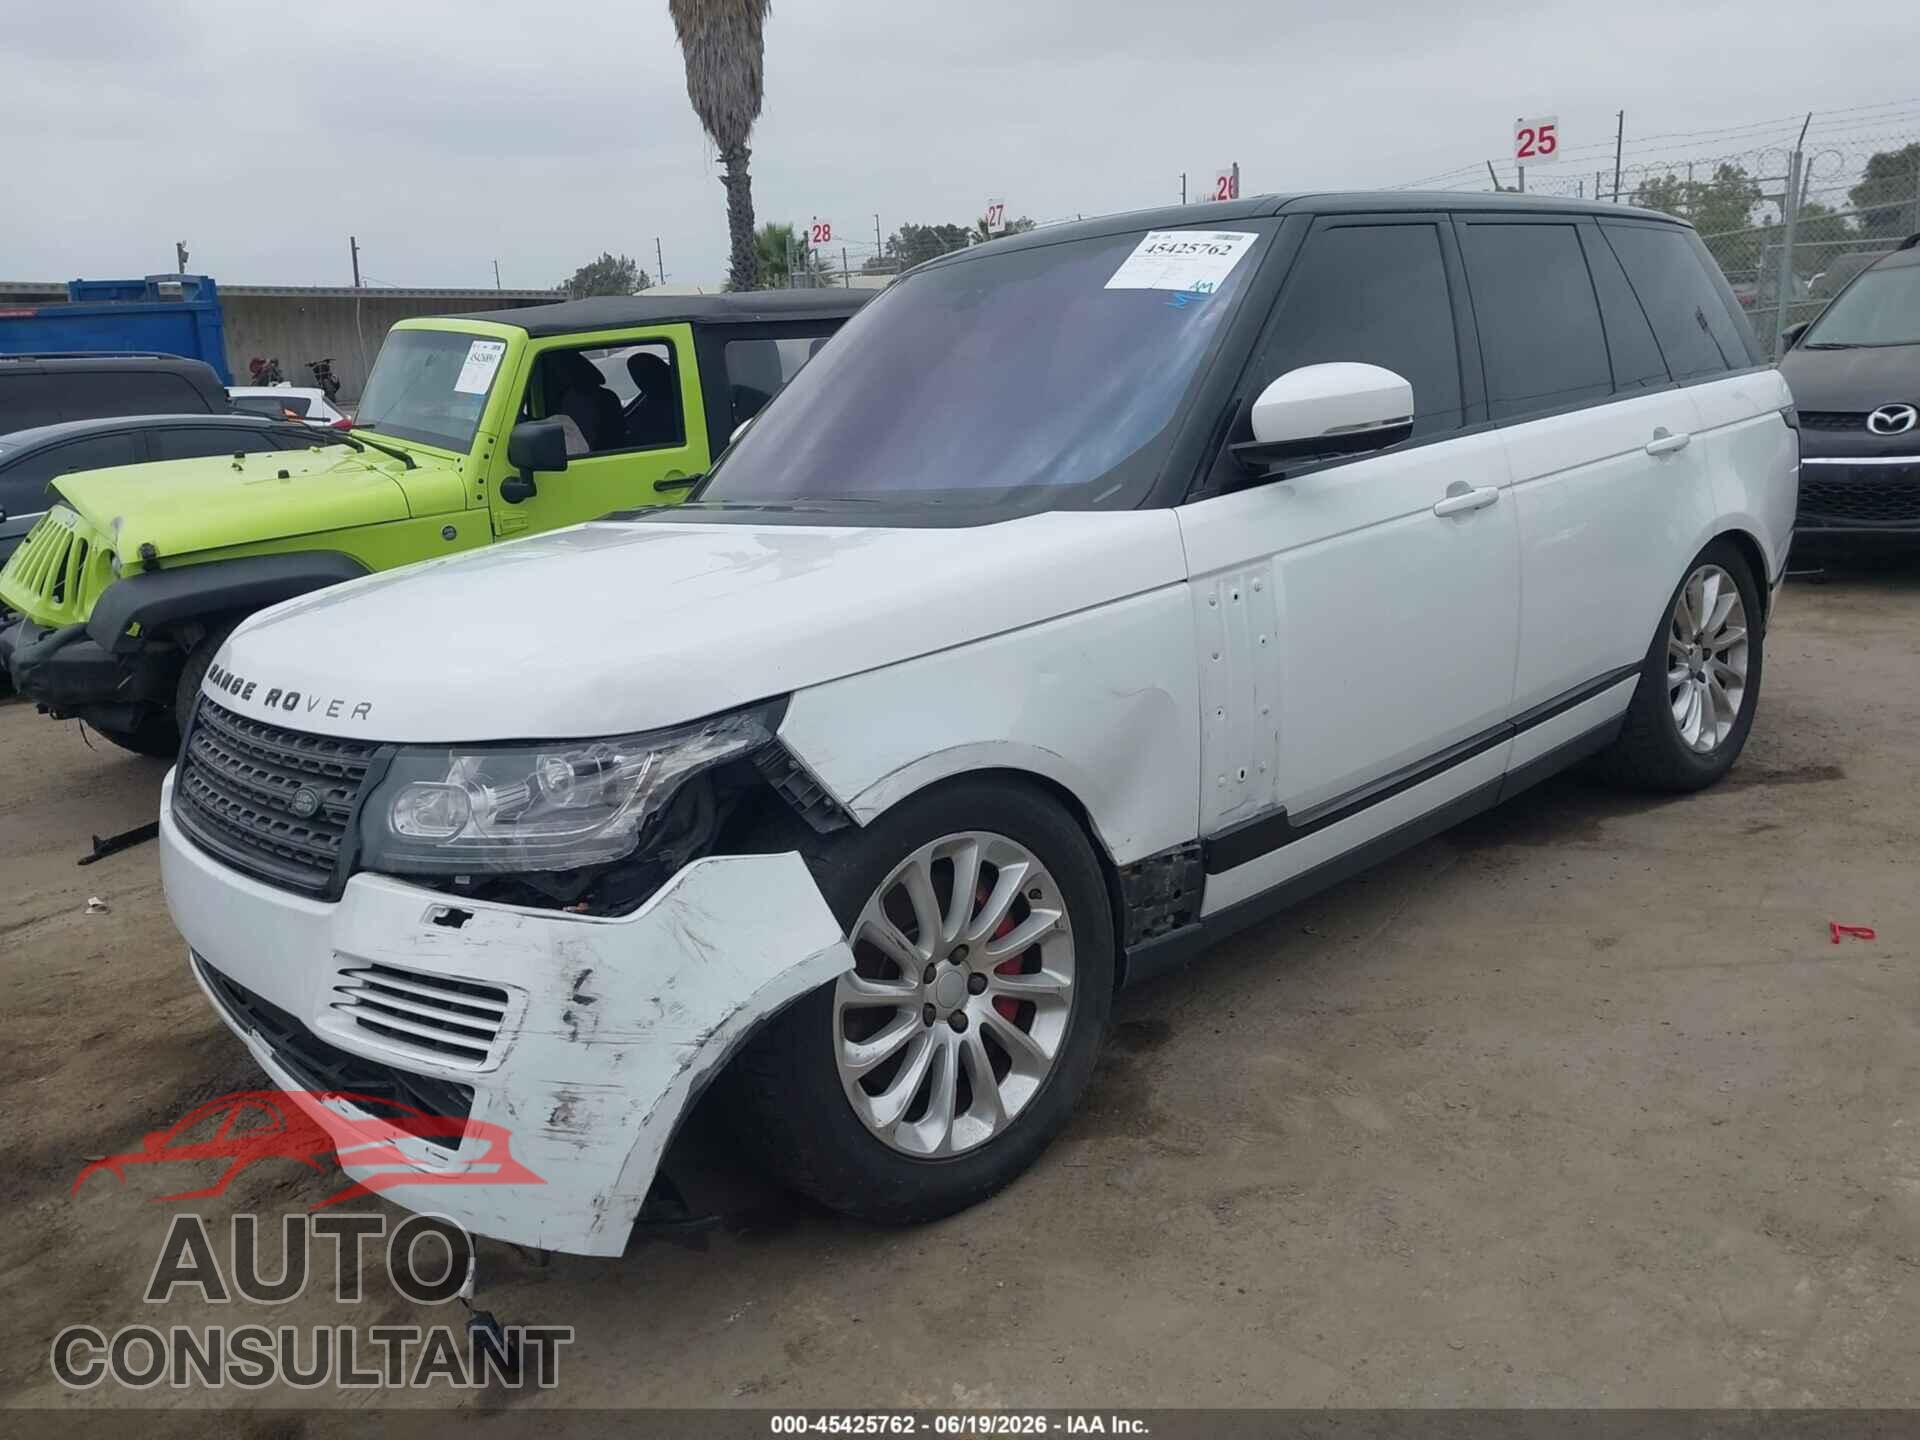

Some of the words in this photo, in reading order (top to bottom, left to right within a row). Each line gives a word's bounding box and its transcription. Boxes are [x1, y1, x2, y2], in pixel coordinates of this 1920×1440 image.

[1517, 125, 1556, 158] 25
[989, 204, 1004, 227] 27
[812, 224, 831, 243] 28
[1144, 243, 1232, 256] 45425762
[207, 664, 257, 701] RANGE
[263, 688, 372, 721] ROVER
